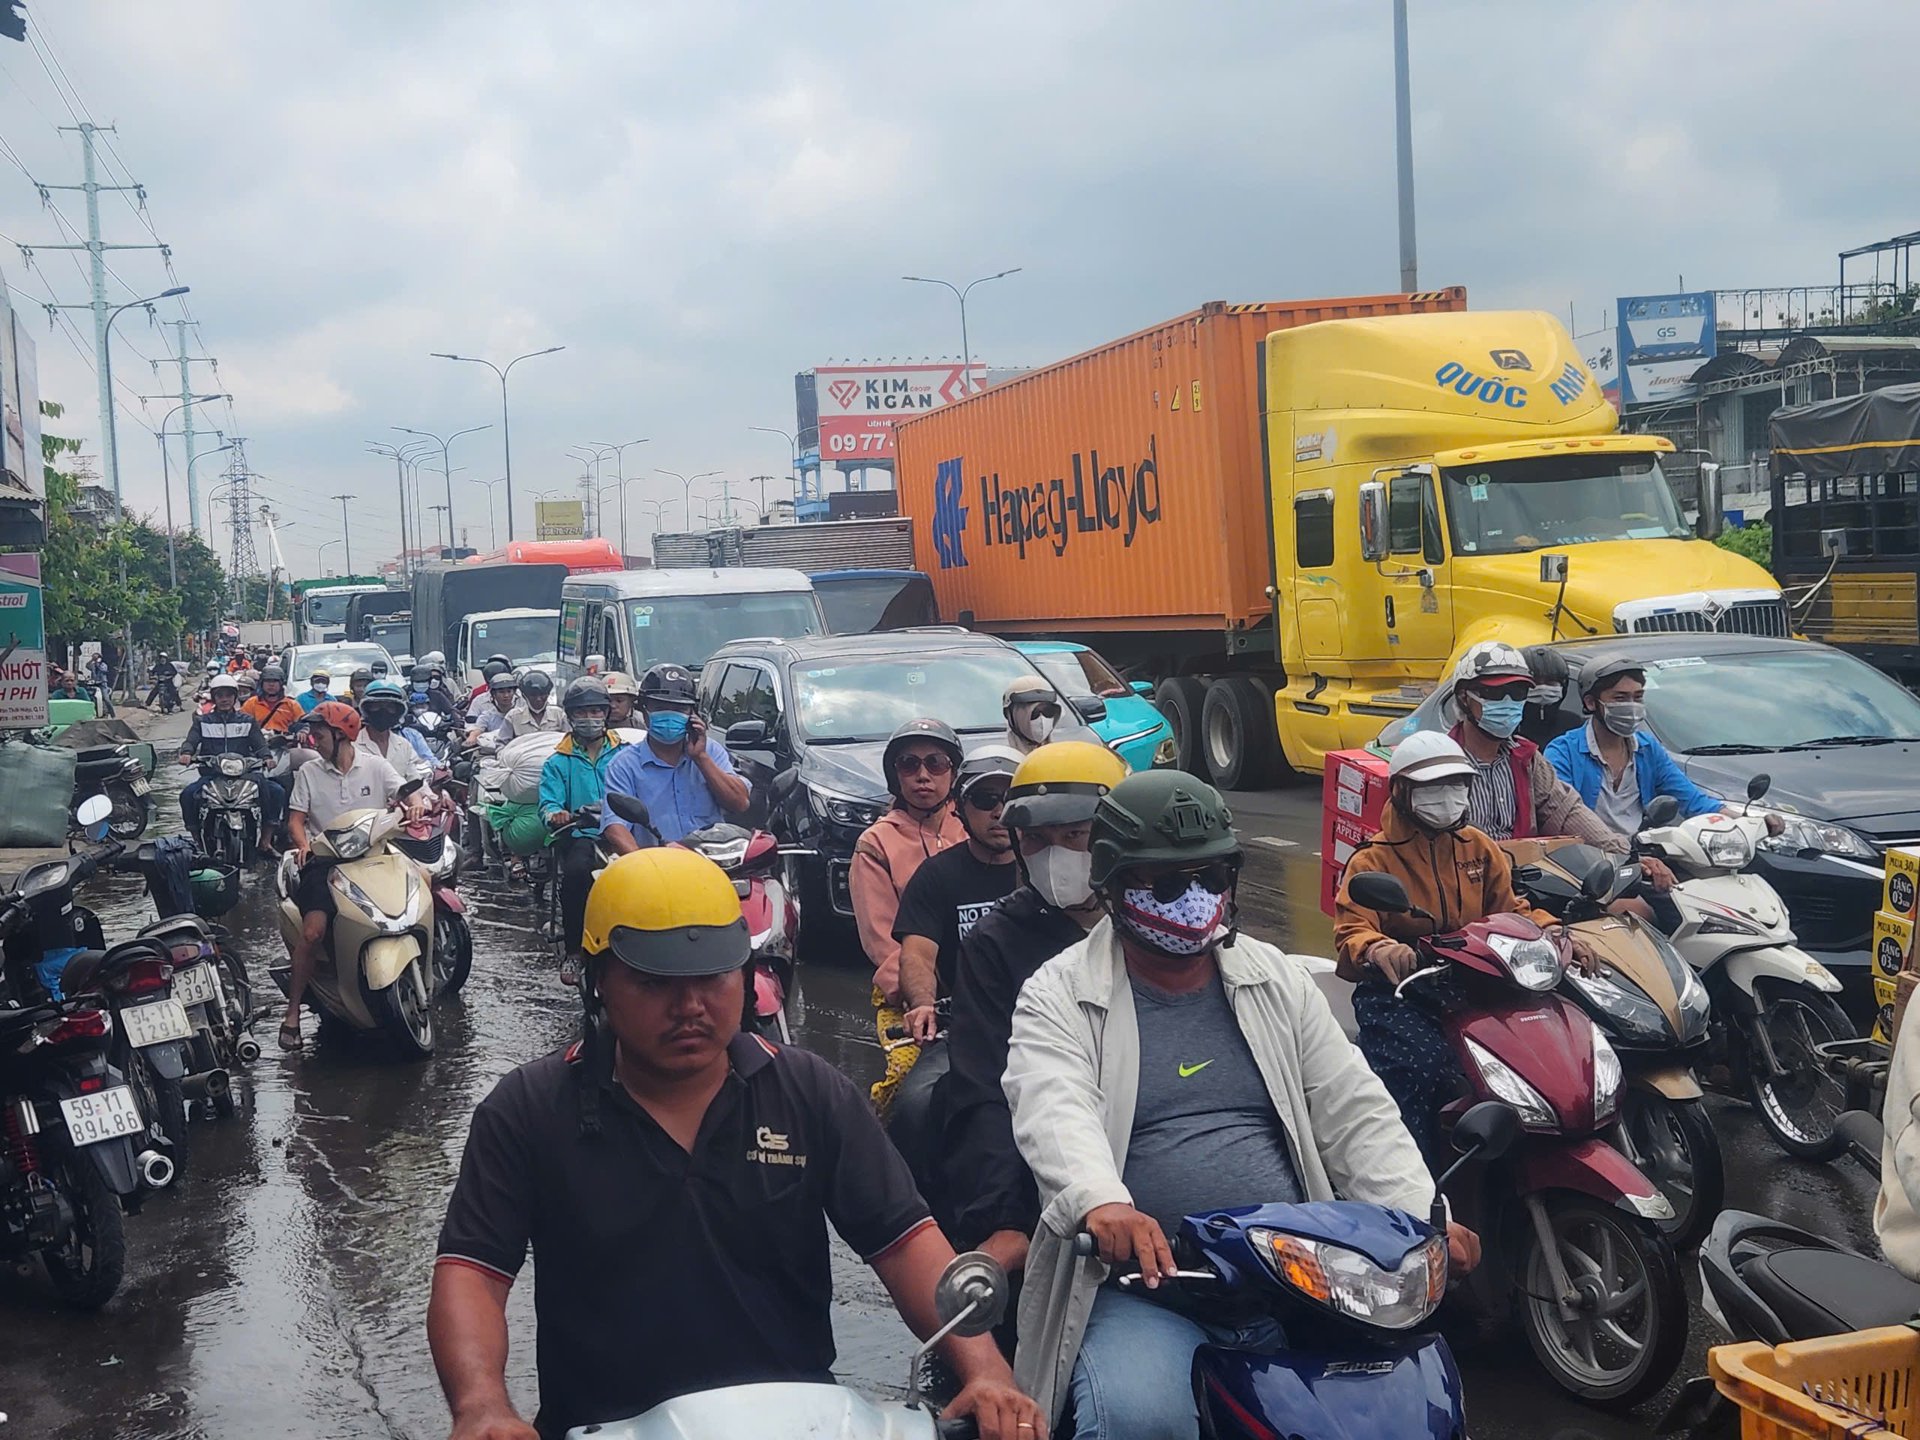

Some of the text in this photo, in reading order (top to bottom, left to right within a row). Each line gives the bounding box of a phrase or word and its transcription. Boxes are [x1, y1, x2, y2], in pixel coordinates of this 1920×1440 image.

[1657, 327, 1676, 338] GS
[865, 378, 908, 394] KIM
[1435, 361, 1586, 409] QUỐC ANH
[866, 393, 932, 410] NGAN
[980, 433, 1162, 560] Hapag-Lloyd
[0, 658, 41, 681] NHỚT
[9, 686, 38, 701] PHI
[1336, 823, 1362, 844] APPLES
[1904, 860, 1914, 872] 30
[1892, 890, 1903, 906] 03
[958, 908, 979, 923] NO
[1892, 924, 1902, 937] 30
[1881, 954, 1892, 969] 03
[130, 1003, 175, 1025] 54-Y1
[136, 1020, 182, 1043] 1294
[70, 1090, 123, 1120] 59-Y1
[72, 1110, 139, 1143] 894.86
